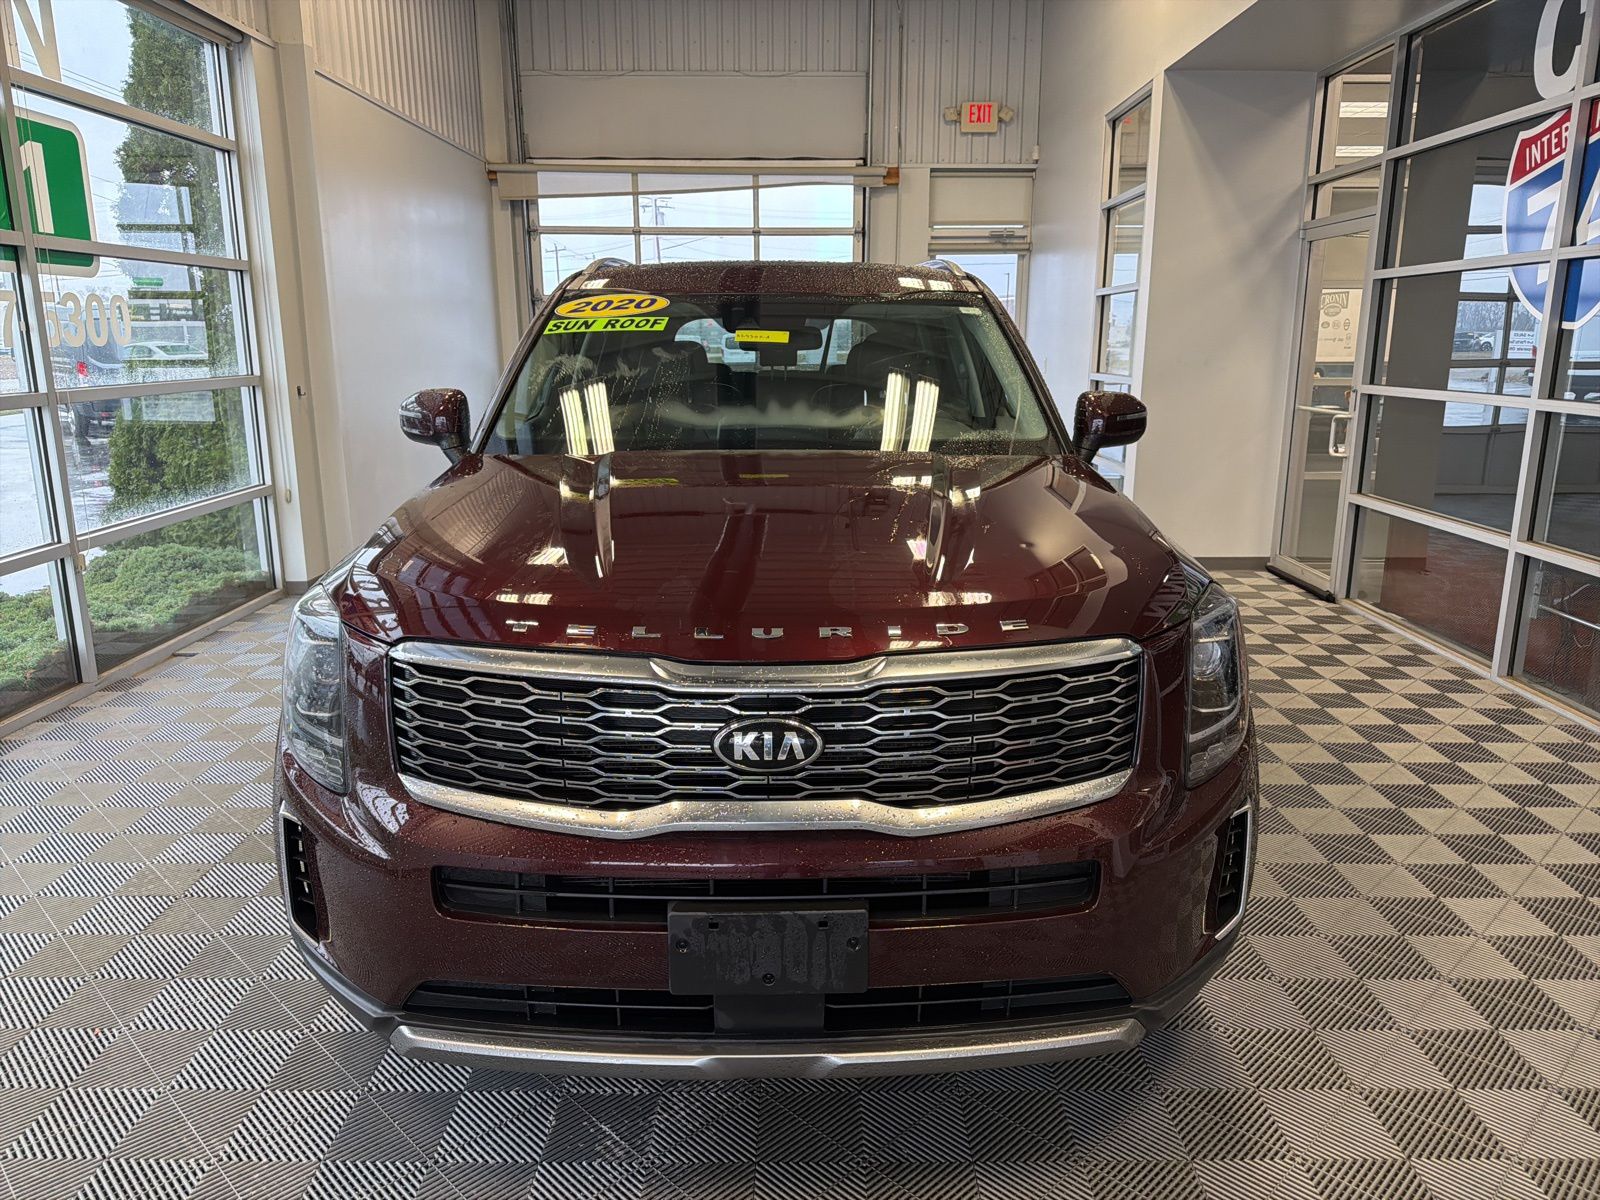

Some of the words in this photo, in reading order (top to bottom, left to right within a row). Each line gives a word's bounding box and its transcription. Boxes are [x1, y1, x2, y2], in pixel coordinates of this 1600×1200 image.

[969, 104, 992, 123] EXIT
[566, 298, 658, 314] 2020
[547, 319, 598, 332] SUN
[602, 318, 665, 330] ROOF
[505, 619, 1029, 640] TELLURIDE
[732, 731, 805, 760] KIA
